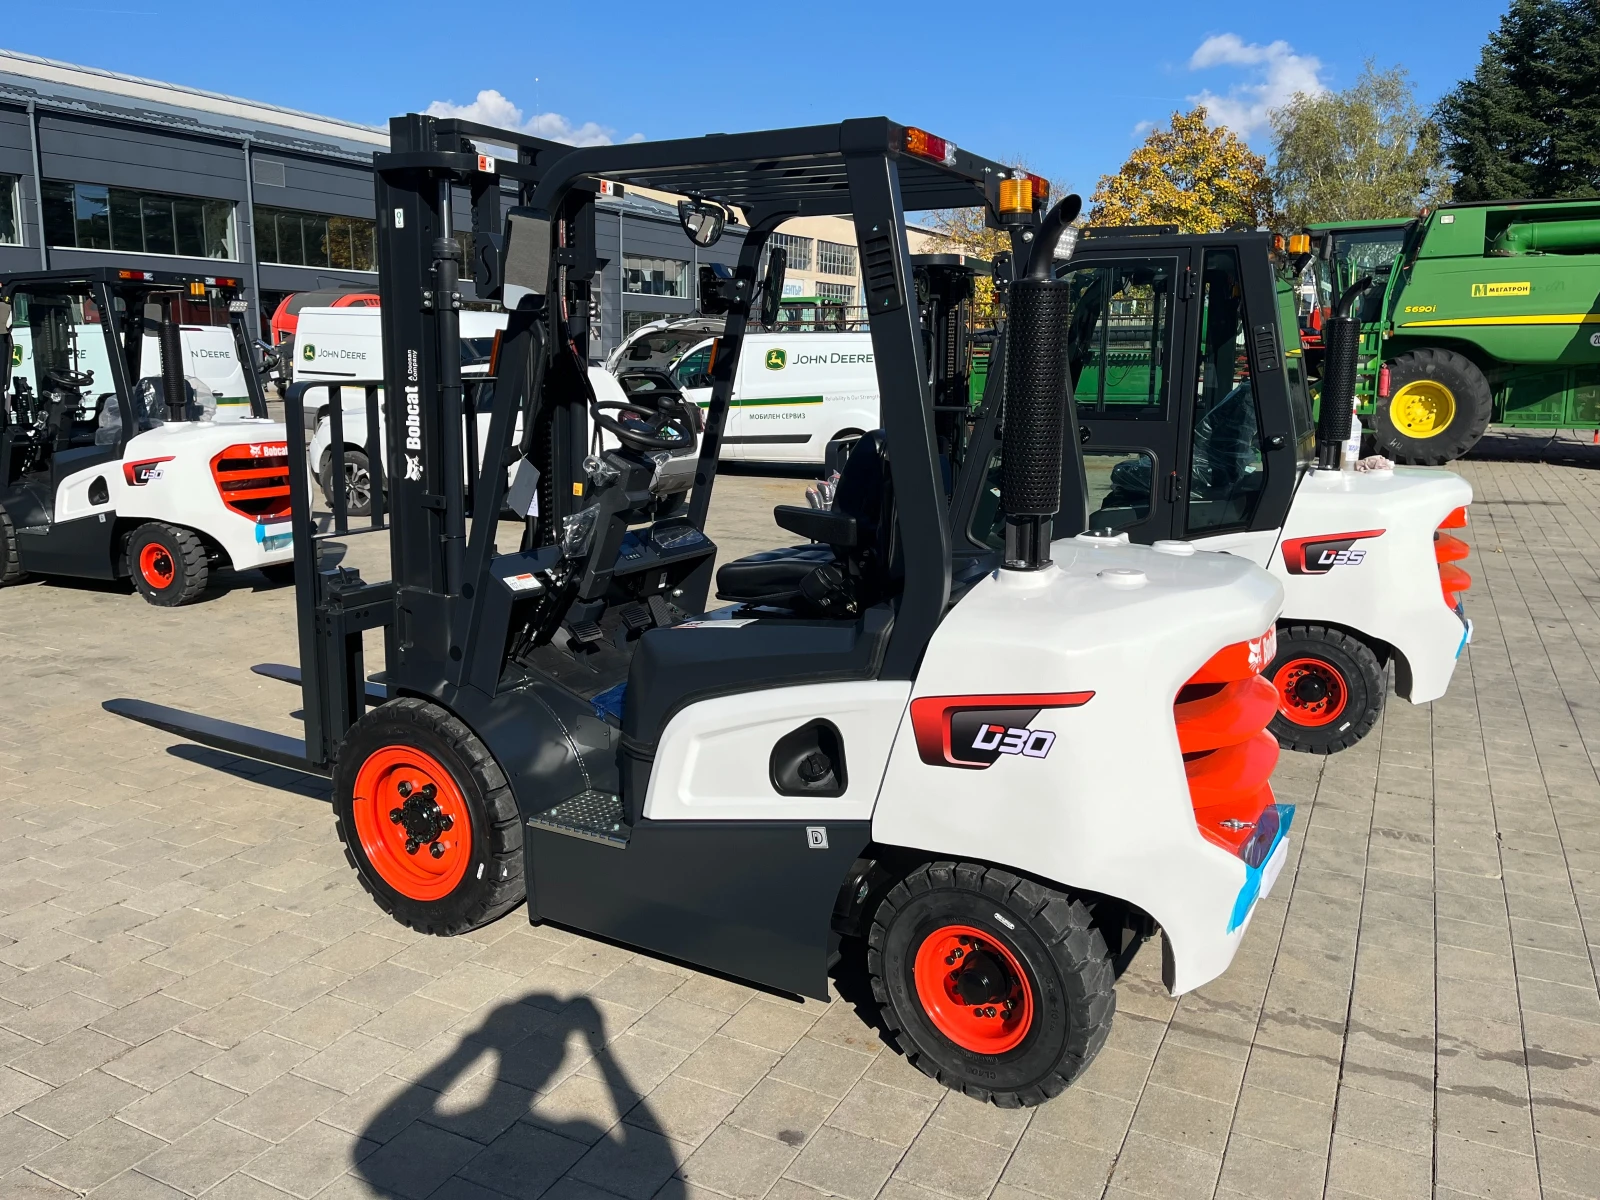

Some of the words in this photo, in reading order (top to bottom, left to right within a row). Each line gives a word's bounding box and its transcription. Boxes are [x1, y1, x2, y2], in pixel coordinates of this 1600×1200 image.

[1404, 305, 1437, 313] S690i
[200, 349, 231, 359] DEERE
[318, 349, 339, 359] JOHN
[340, 350, 367, 360] DEERE
[793, 353, 828, 365] JOHN
[830, 353, 874, 364] DEERE
[404, 385, 421, 450] Bobcat
[140, 469, 164, 480] D30
[1317, 550, 1367, 566] D35
[972, 723, 1057, 760] D30
